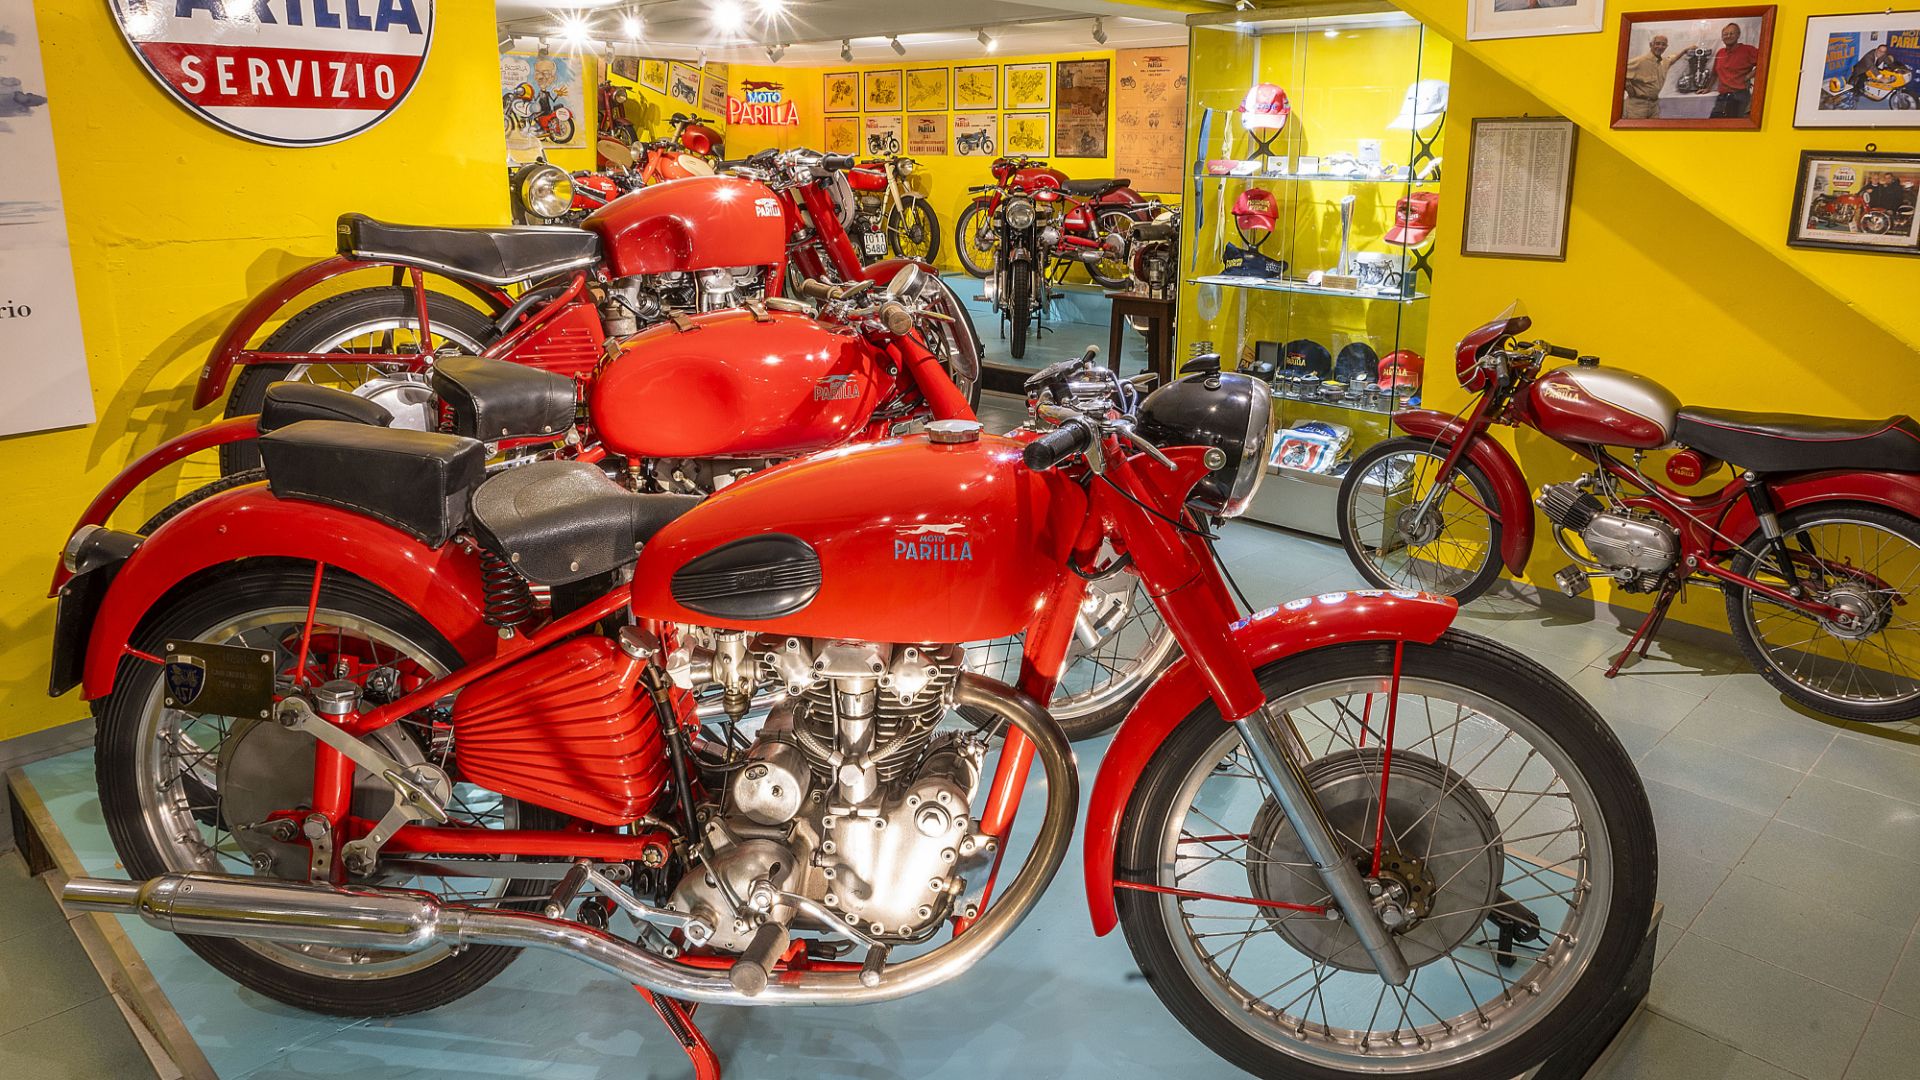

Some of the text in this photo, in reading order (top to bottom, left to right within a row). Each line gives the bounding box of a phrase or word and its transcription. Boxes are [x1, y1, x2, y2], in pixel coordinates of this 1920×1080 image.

[180, 55, 397, 100] SERVIZIO
[747, 91, 781, 104] MOTO
[729, 97, 800, 125] PARILLA
[866, 244, 887, 254] 5480
[814, 384, 860, 401] PARILLA
[895, 539, 973, 560] PARILLA
